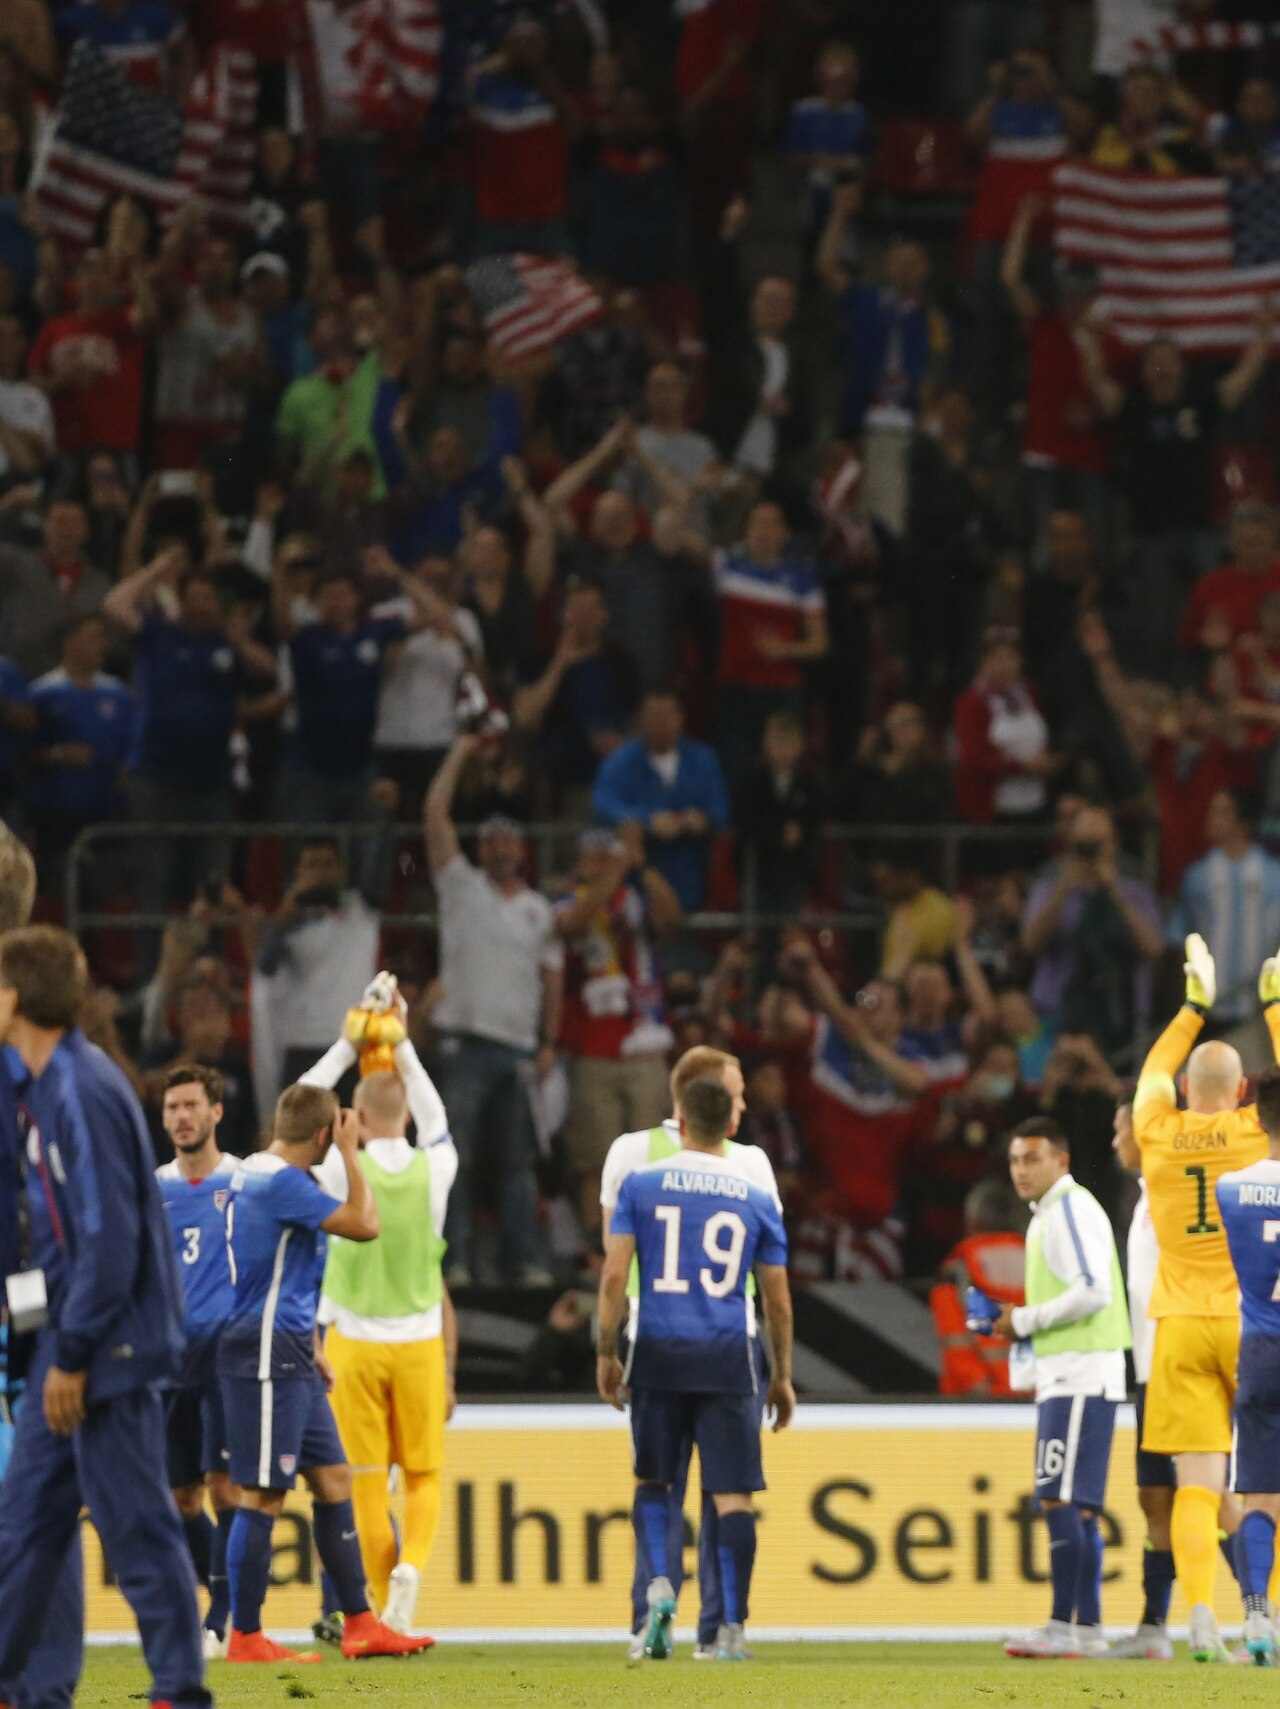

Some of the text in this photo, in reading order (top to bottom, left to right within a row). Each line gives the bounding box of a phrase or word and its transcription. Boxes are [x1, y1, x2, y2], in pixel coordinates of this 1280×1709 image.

[662, 1169, 748, 1200] ALVARADO
[1185, 1165, 1219, 1234] 1
[182, 1226, 201, 1265] 3
[653, 1204, 748, 1298] 19
